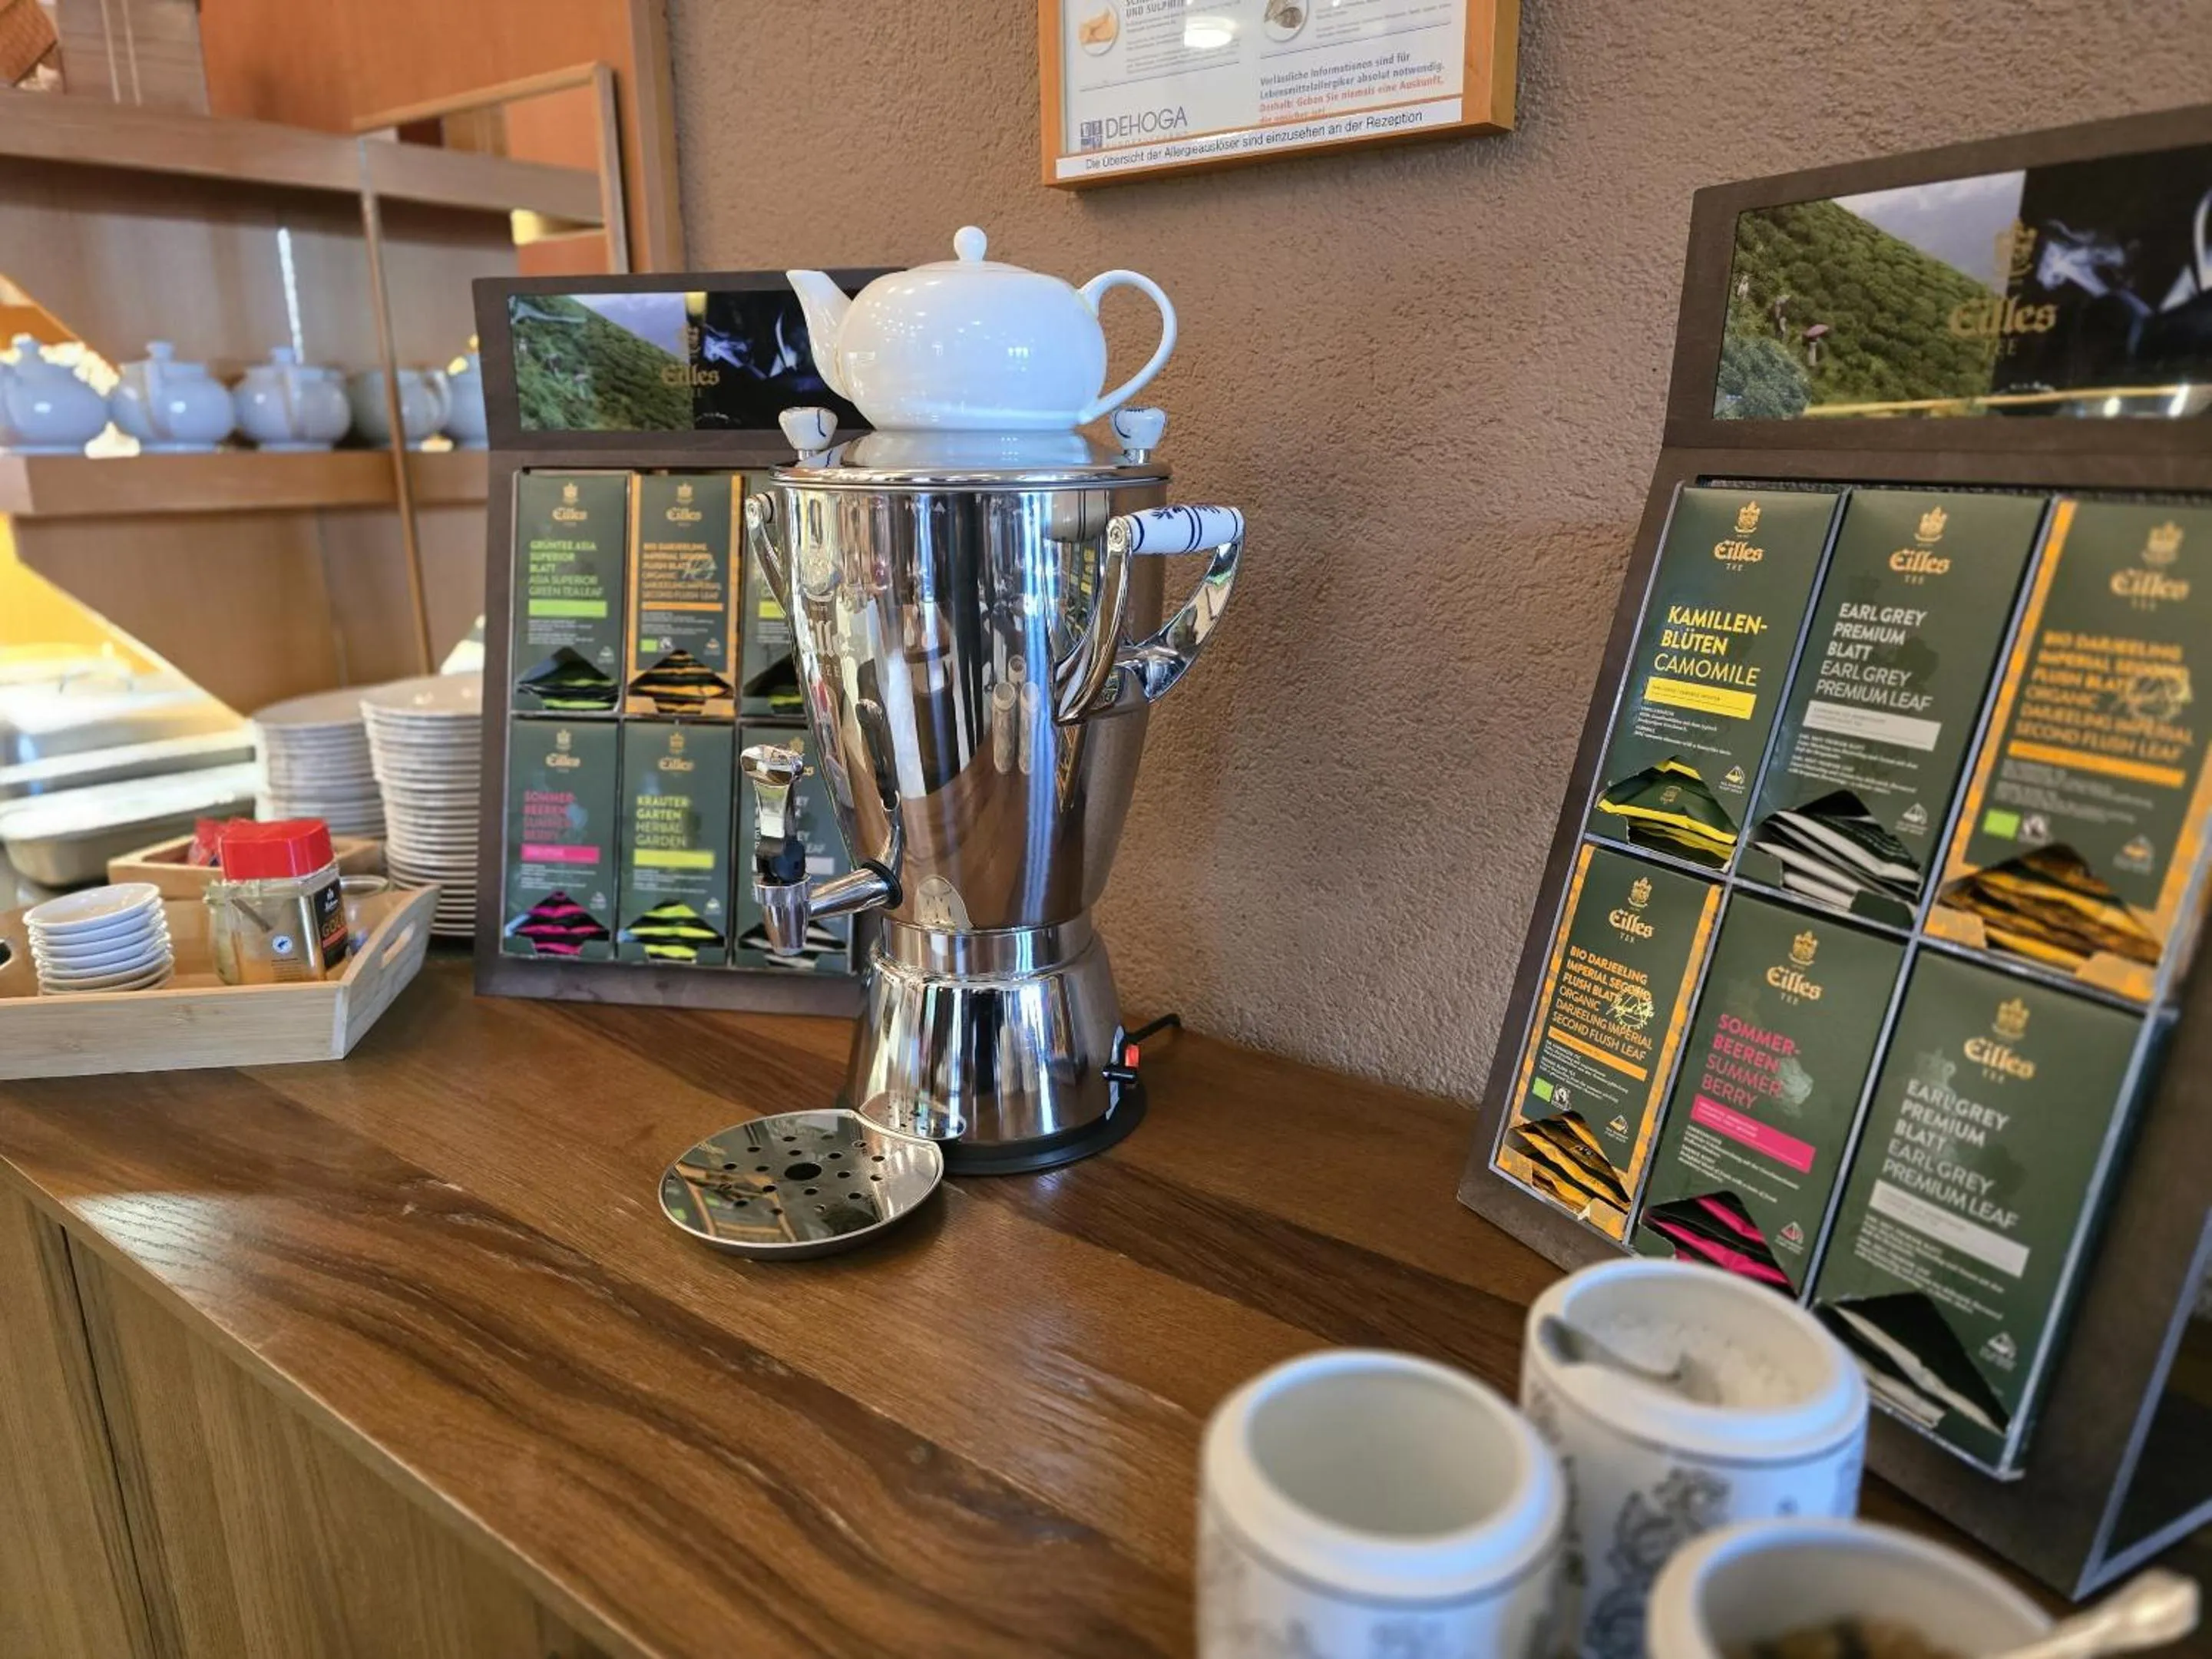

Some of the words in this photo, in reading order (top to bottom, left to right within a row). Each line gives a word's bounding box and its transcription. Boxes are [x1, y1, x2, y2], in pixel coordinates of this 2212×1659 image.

[1311, 61, 1373, 77] Informationen
[1375, 55, 1394, 67] sind
[1397, 51, 1410, 63] für
[1357, 70, 1390, 83] absolut
[1296, 95, 1323, 107] Geben
[1325, 92, 1339, 102] Sie
[1341, 86, 1374, 99] niemals
[1377, 84, 1397, 93] eine
[1106, 106, 1188, 139] DEHOGA
[1086, 158, 1100, 170] Die
[1103, 150, 1145, 167] Übersicht
[1147, 150, 1162, 160] der
[1243, 134, 1263, 147] sind
[1267, 124, 1325, 144] einzusehen
[1328, 124, 1342, 135] an
[1344, 119, 1363, 132] der
[1367, 111, 1423, 129] Rezeption
[1714, 540, 1764, 562] Eilles
[1890, 549, 1952, 574] Eilles
[1668, 606, 1767, 635] KAMILLEN-
[1840, 603, 1880, 623] EARL
[1881, 607, 1927, 627] GREY
[1661, 626, 1728, 656] BLÜTEN
[1833, 623, 1906, 646] PREMIUM
[2075, 634, 2183, 661] DARJEELING
[1827, 642, 1873, 661] BLATT
[2038, 649, 2108, 671] IMPERIAL
[1654, 653, 1760, 686] CAMOMILE
[1821, 660, 1865, 680] EARL
[1866, 668, 1913, 688] GREY
[2032, 666, 2082, 685] FLUSH
[1816, 679, 1890, 704] PREMIUM
[1890, 691, 1934, 712] LEAF
[2025, 685, 2098, 706] ORGANIC
[2016, 719, 2081, 742] SECOND
[2082, 732, 2136, 755] FLUSH
[2138, 742, 2184, 763] LEAF
[636, 808, 682, 820] GARTEN
[636, 821, 683, 834] HERBAL
[635, 834, 686, 848] GARDEN
[1609, 909, 1655, 938] Eilles
[1566, 960, 1608, 985] IMPERIAL
[1570, 946, 1587, 960] BIO
[1588, 953, 1648, 985] DARJEELING
[1563, 972, 1592, 992] FLUSH
[1767, 966, 1823, 1000] Eilles
[1559, 986, 1601, 1011] ORGANIC
[1552, 1011, 1589, 1036] SECOND
[1589, 1026, 1620, 1051] FLUSH
[1621, 1042, 1647, 1061] LEAF
[1556, 998, 1608, 1029] DARJEELING
[1608, 1021, 1653, 1050] IMPERIAL
[1718, 1013, 1801, 1056] SOMMER-
[1713, 1033, 1781, 1073] BEEREN
[1964, 1037, 2036, 1079] Eilles
[1705, 1054, 1784, 1098] SUMMER
[1701, 1072, 1758, 1110] BERRY
[1908, 1079, 1955, 1111] EARL
[1956, 1099, 2010, 1131] GREY
[1894, 1119, 1946, 1153] BLATT
[1901, 1099, 1986, 1147] PREMIUM
[1887, 1139, 1935, 1174] EARL
[1937, 1160, 1995, 1195] GREY
[1882, 1159, 1969, 1215] PREMIUM
[1969, 1201, 2019, 1229] LEAF
